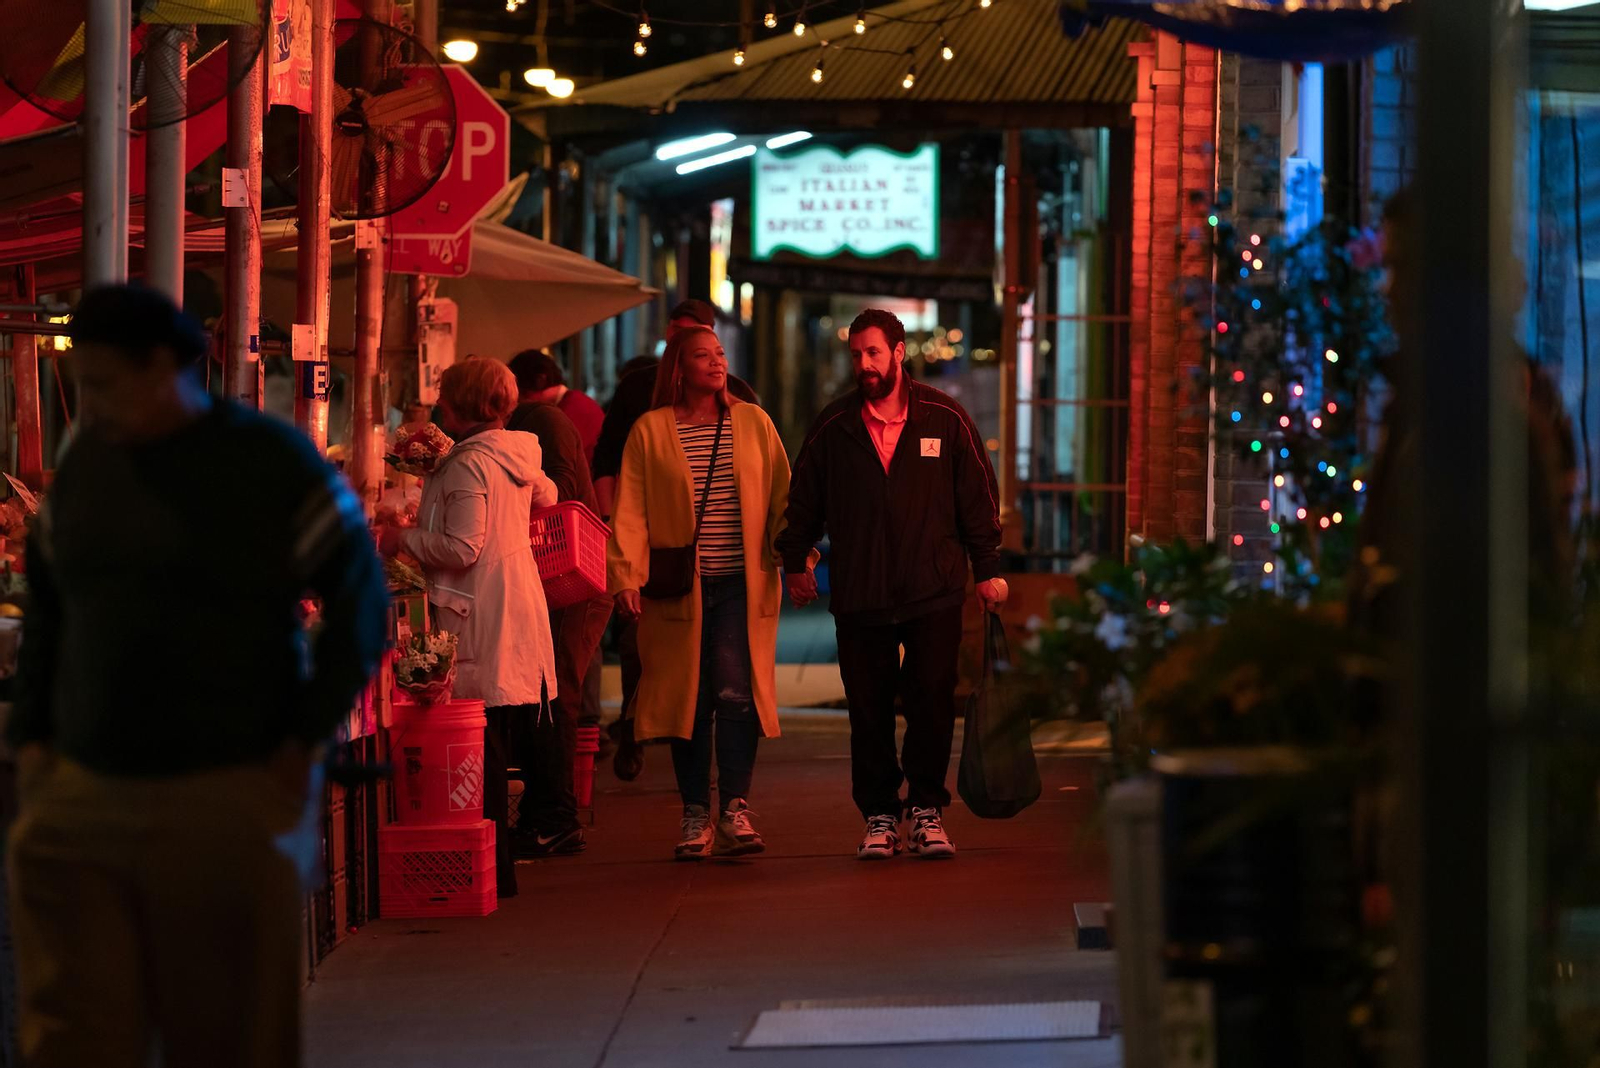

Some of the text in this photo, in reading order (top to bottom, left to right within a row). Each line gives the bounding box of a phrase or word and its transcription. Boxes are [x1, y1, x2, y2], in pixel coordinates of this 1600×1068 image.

[384, 119, 496, 181] TOP
[801, 178, 889, 193] ITALIAN
[799, 199, 890, 212] MARKET
[767, 217, 825, 232] SPICE
[428, 239, 463, 258] WAY
